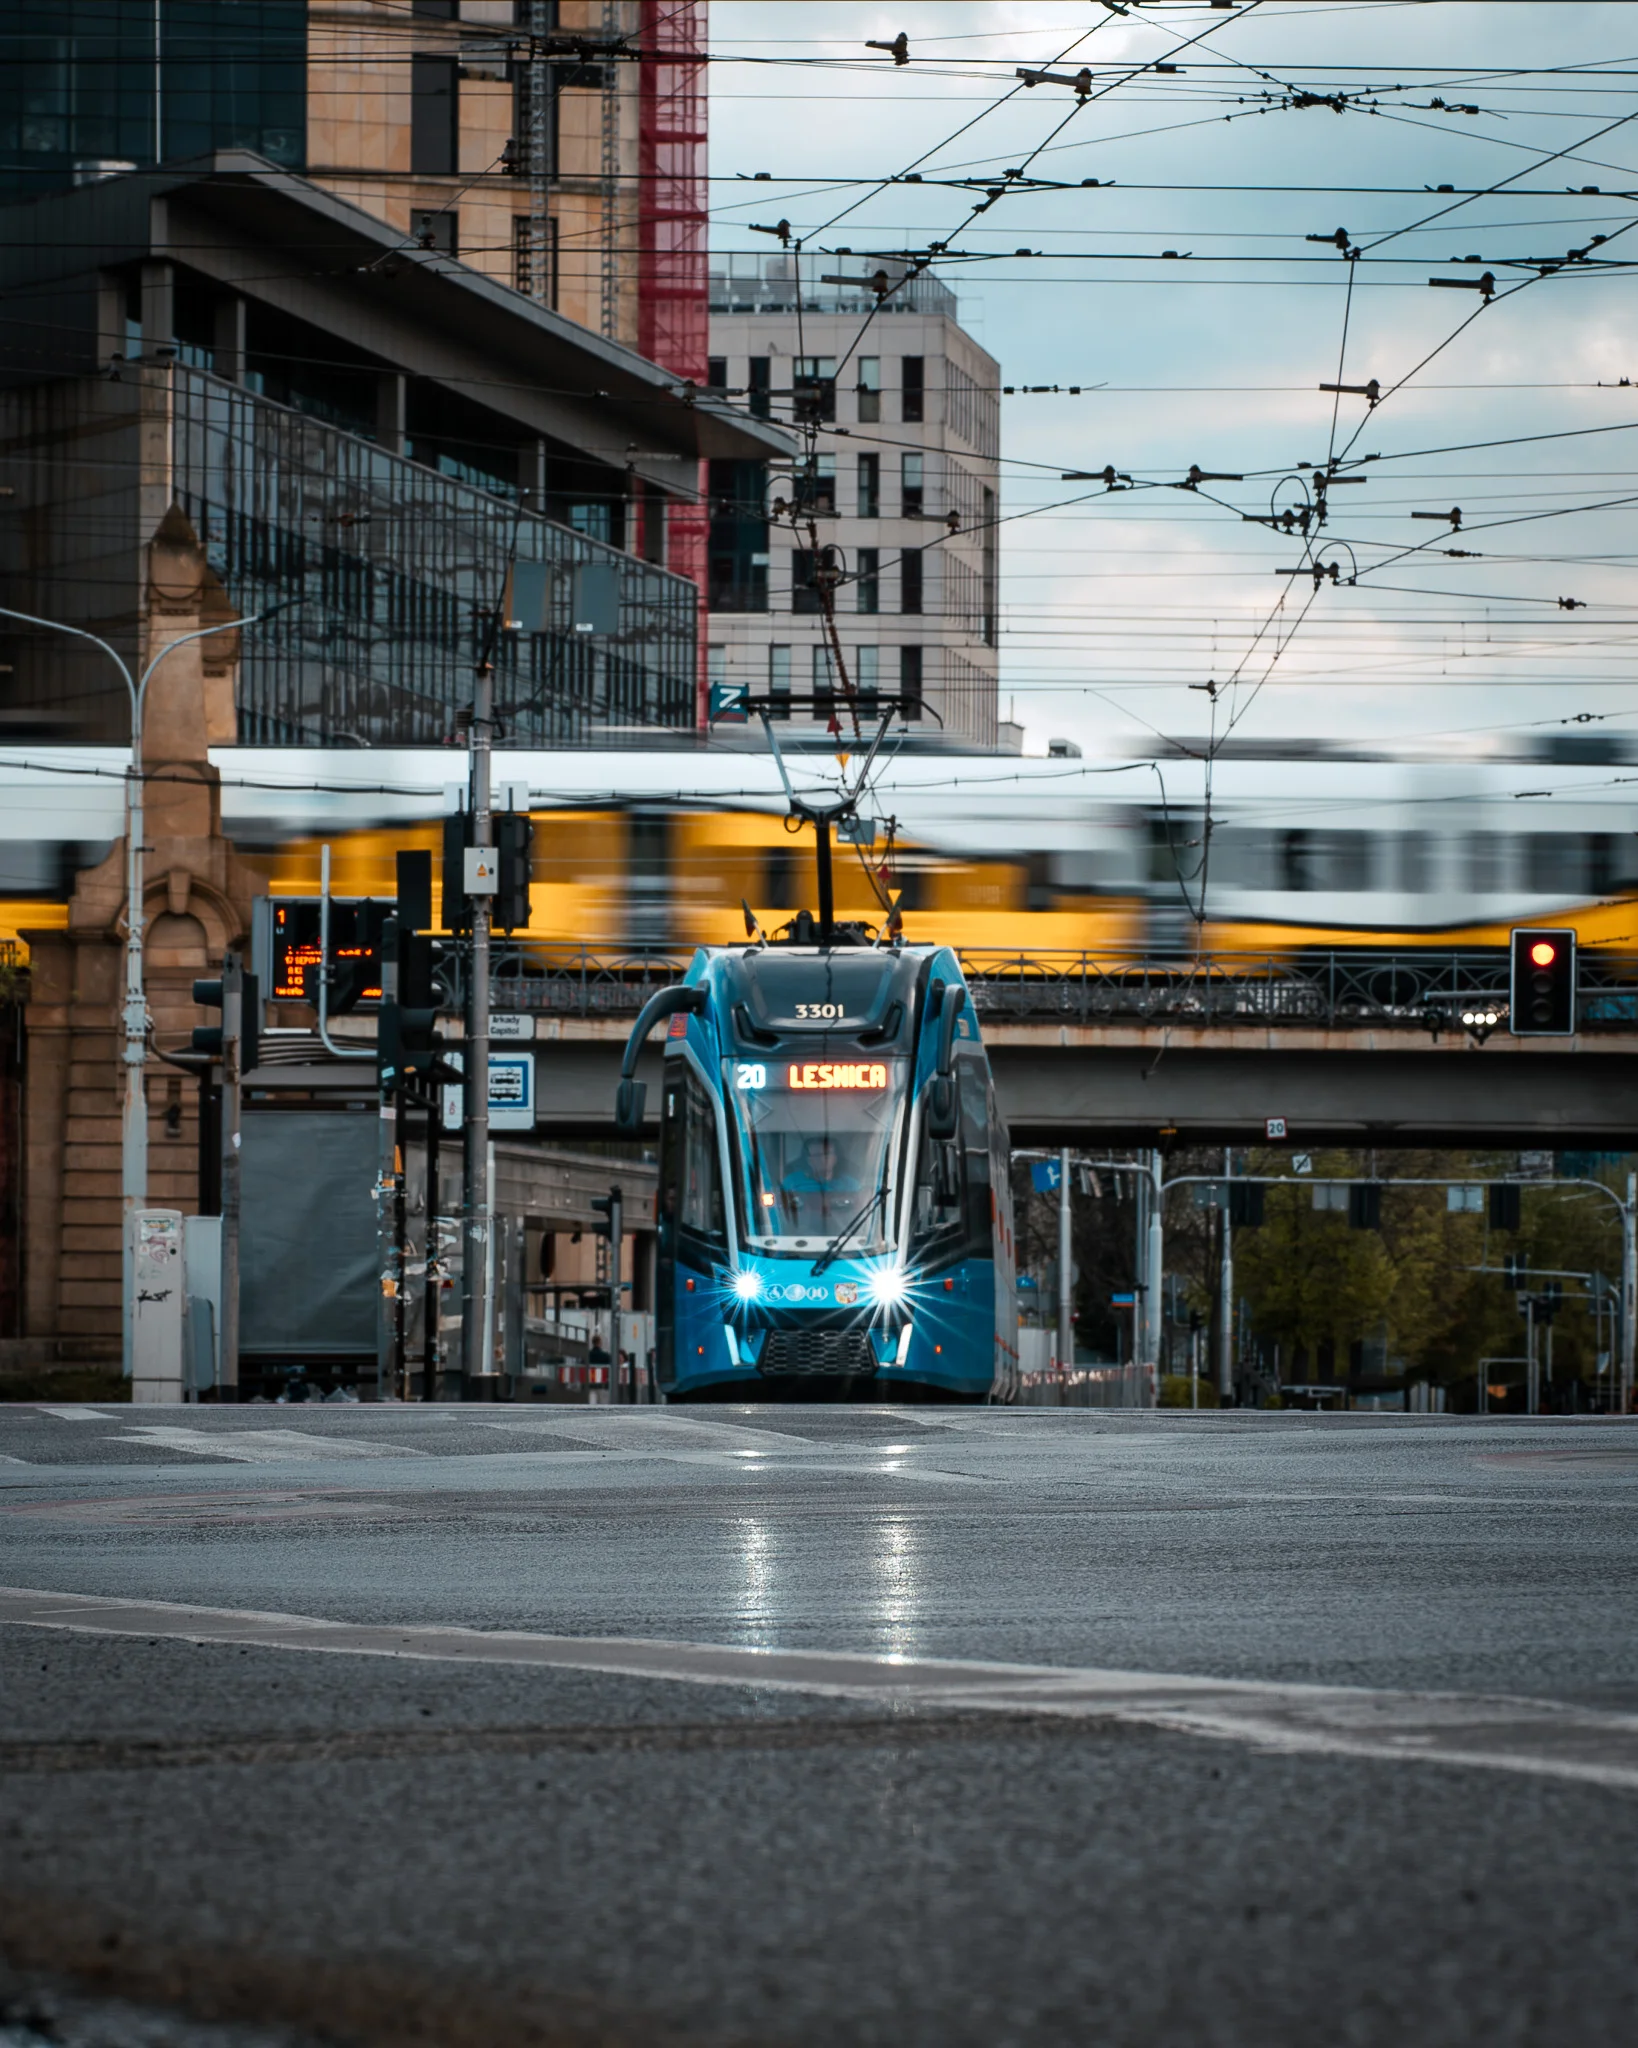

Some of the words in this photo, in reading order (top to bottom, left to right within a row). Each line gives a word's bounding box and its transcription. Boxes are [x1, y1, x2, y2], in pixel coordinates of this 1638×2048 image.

[719, 688, 741, 708] Z
[795, 1004, 844, 1019] 3301
[492, 1015, 520, 1026] Arkady
[490, 1026, 519, 1036] Capitol
[737, 1064, 767, 1089] 20
[789, 1064, 886, 1089] LESNICA
[1269, 1122, 1284, 1134] 20
